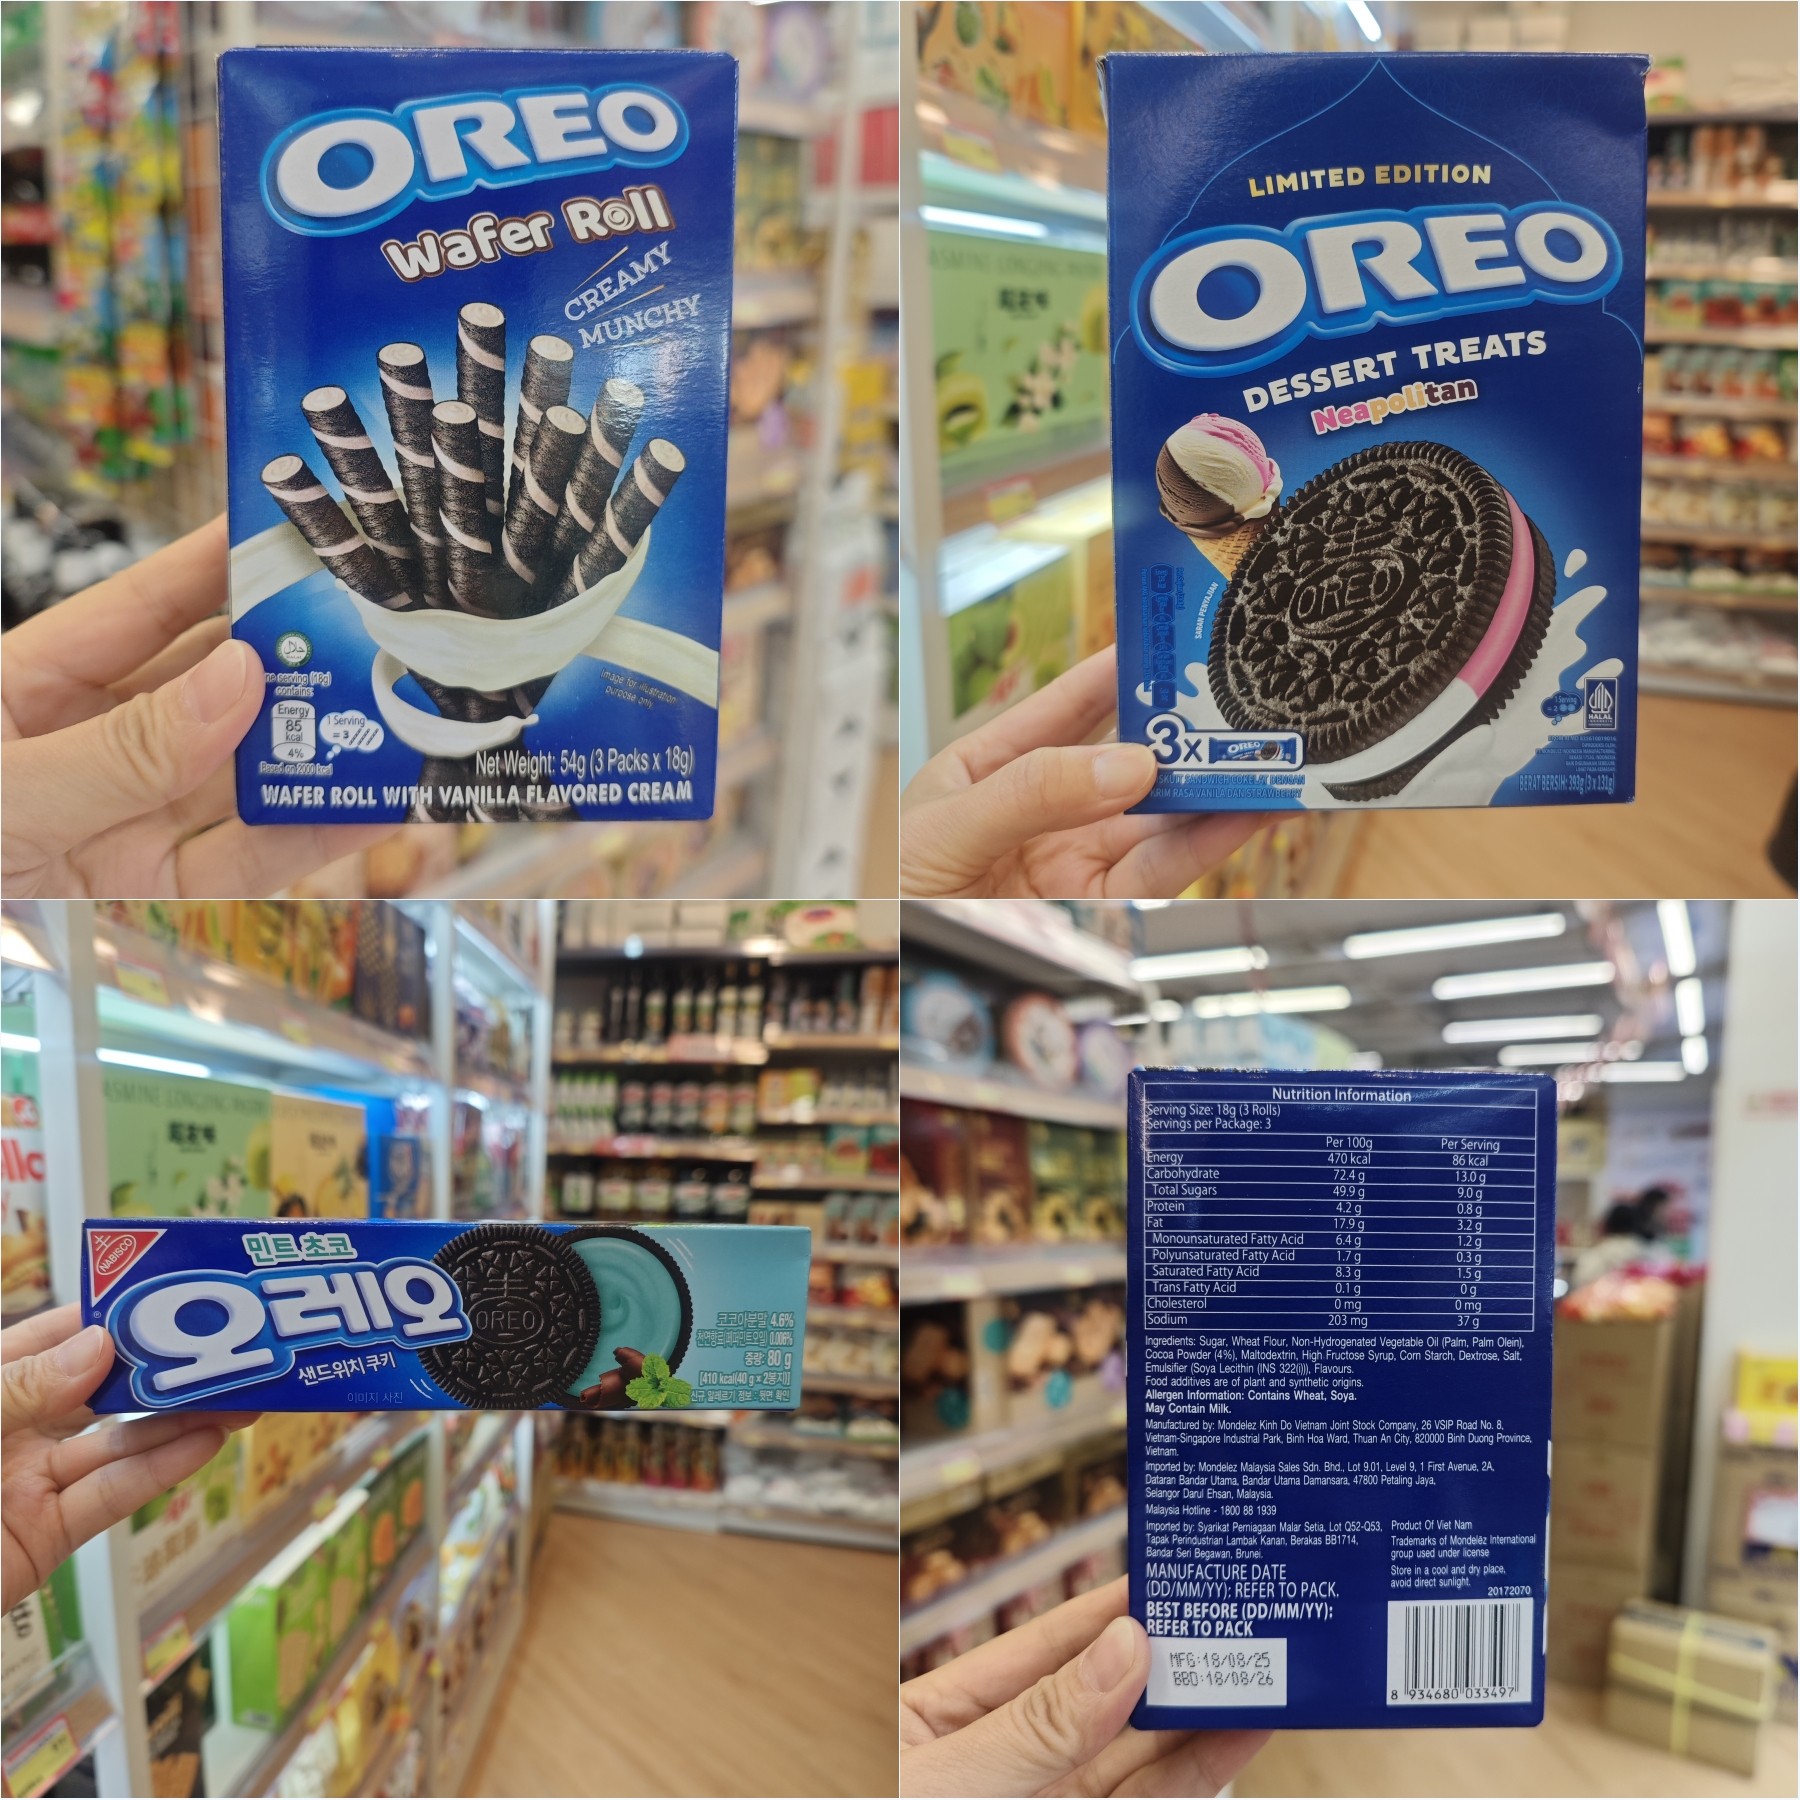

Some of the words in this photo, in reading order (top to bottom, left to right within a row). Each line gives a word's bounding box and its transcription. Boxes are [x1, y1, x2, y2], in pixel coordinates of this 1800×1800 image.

[277, 91, 678, 218] OREO
[1249, 167, 1365, 198] LIMITED
[1375, 164, 1491, 184] EDITION
[383, 212, 552, 282] Wafer
[565, 186, 672, 241] Roll
[564, 242, 671, 322] CREAMY
[1149, 212, 1607, 352] OREO
[579, 294, 701, 349] MUNCHY
[1243, 351, 1397, 412] DESSERT
[1411, 331, 1547, 369] TREATS
[1311, 379, 1478, 434] Neapolitan
[1297, 568, 1390, 618] OREO
[265, 673, 276, 682] ne
[279, 673, 308, 685] serving
[277, 685, 314, 697] contains:
[278, 704, 310, 717] Energy
[286, 720, 302, 732] 85
[334, 715, 365, 727] Serving
[286, 731, 303, 742] kcal
[288, 748, 304, 758] 4%
[1228, 741, 1260, 753] OREO
[261, 763, 284, 774] Based
[317, 764, 332, 775] kcal
[476, 751, 500, 775] Net
[504, 750, 555, 781] Weight:
[560, 750, 586, 779] 54g
[590, 748, 603, 779] (3
[608, 747, 648, 773] Packs
[652, 752, 661, 770] x
[665, 746, 694, 777] 18g)
[1156, 775, 1183, 785] ISKUIT
[1185, 774, 1230, 785] SANDWICH
[1232, 774, 1269, 785] COKELAT
[1270, 774, 1305, 785] DENGAN
[1520, 774, 1540, 791] BERAT
[1542, 774, 1568, 791] BERSIH:
[1569, 774, 1584, 795] 393g
[262, 784, 325, 806] WAFER
[331, 786, 377, 806] ROLL
[383, 786, 433, 805] WITH
[439, 785, 519, 805] VANILLA
[527, 783, 622, 804] FLAVORED
[628, 780, 692, 803] CREAM
[1173, 788, 1195, 798] RASA
[1196, 788, 1225, 798] VANILA
[1227, 788, 1245, 798] DAN
[1247, 788, 1303, 798] STRAWBERRY
[1272, 1087, 1331, 1101] Nutrition
[1335, 1088, 1412, 1103] Information
[1147, 1104, 1187, 1117] Serving
[1190, 1104, 1214, 1116] Size:
[1218, 1104, 1236, 1118] 18g
[1240, 1104, 1250, 1118] (3
[1253, 1103, 1281, 1117] Rolls)
[1147, 1118, 1192, 1131] Servings
[1195, 1120, 1213, 1132] per
[1215, 1118, 1263, 1132] Package:
[1265, 1118, 1272, 1130] 3
[1326, 1136, 1343, 1148] Per
[1346, 1136, 1373, 1151] 100g
[1441, 1138, 1458, 1150] Per
[1461, 1138, 1500, 1152] Serving
[1147, 1152, 1184, 1165] Energy
[1327, 1153, 1348, 1165] 470
[1350, 1153, 1371, 1165] kcal
[1452, 1155, 1466, 1166] 86
[1468, 1154, 1489, 1167] kcal
[99, 1238, 133, 1272] NABISCO
[243, 1233, 301, 1265] 민트
[301, 1233, 356, 1260] 초코
[130, 1266, 463, 1387] 오레오
[475, 1310, 536, 1331] OREO
[717, 1312, 768, 1329] 코코아분말
[770, 1312, 794, 1328] 4.6%
[1145, 1335, 1196, 1348] Ingredients:
[1199, 1336, 1229, 1349] Sugar,
[1231, 1336, 1260, 1348] Wheat
[1263, 1336, 1289, 1348] Flour,
[1291, 1336, 1376, 1349] Non-Hydrogenated
[1379, 1337, 1424, 1349] Vegetable
[1426, 1336, 1439, 1348] Oil
[1442, 1336, 1469, 1349] (Palm,
[1472, 1337, 1494, 1348] Palm
[1497, 1336, 1524, 1349] Olein),
[745, 1352, 765, 1367] 중량:
[767, 1349, 781, 1367] 80
[784, 1352, 792, 1370] g
[298, 1357, 366, 1386] 샌드위치
[366, 1351, 396, 1372] 쿠키
[748, 1373, 755, 1387] g
[347, 1392, 379, 1404] 이미지
[382, 1391, 403, 1404] 사진
[691, 1390, 705, 1402] 신규
[707, 1390, 736, 1402] 알레르기
[738, 1390, 752, 1402] 정보
[775, 1390, 790, 1402] 확인
[1145, 1389, 1184, 1402] Allergen
[1187, 1390, 1245, 1401] Information:
[1247, 1390, 1291, 1401] Contains
[1294, 1390, 1327, 1402] Wheat,
[1330, 1390, 1357, 1403] Soya.
[1145, 1403, 1166, 1415] May
[1168, 1403, 1206, 1414] Contain
[1209, 1403, 1232, 1414] Milk.
[1145, 1563, 1248, 1581] MANUFACTURE
[1251, 1564, 1287, 1581] DATE
[1146, 1580, 1232, 1600] (DD/MM/YY):
[1235, 1581, 1275, 1599] REFER
[1278, 1581, 1297, 1598] TO
[1301, 1581, 1340, 1599] PACK.
[1487, 1585, 1532, 1597] 20172070
[1146, 1601, 1181, 1618] BEST
[1184, 1602, 1239, 1619] BEFORE
[1241, 1603, 1334, 1621] (DD/MM/YY):
[1146, 1620, 1189, 1636] REFER
[1192, 1621, 1212, 1636] TO
[1215, 1621, 1254, 1637] PACK
[1169, 1651, 1271, 1668] MFG:18/08/25
[1391, 1689, 1398, 1700] 8
[1408, 1688, 1459, 1700] 934680
[1465, 1686, 1515, 1699] 033497
